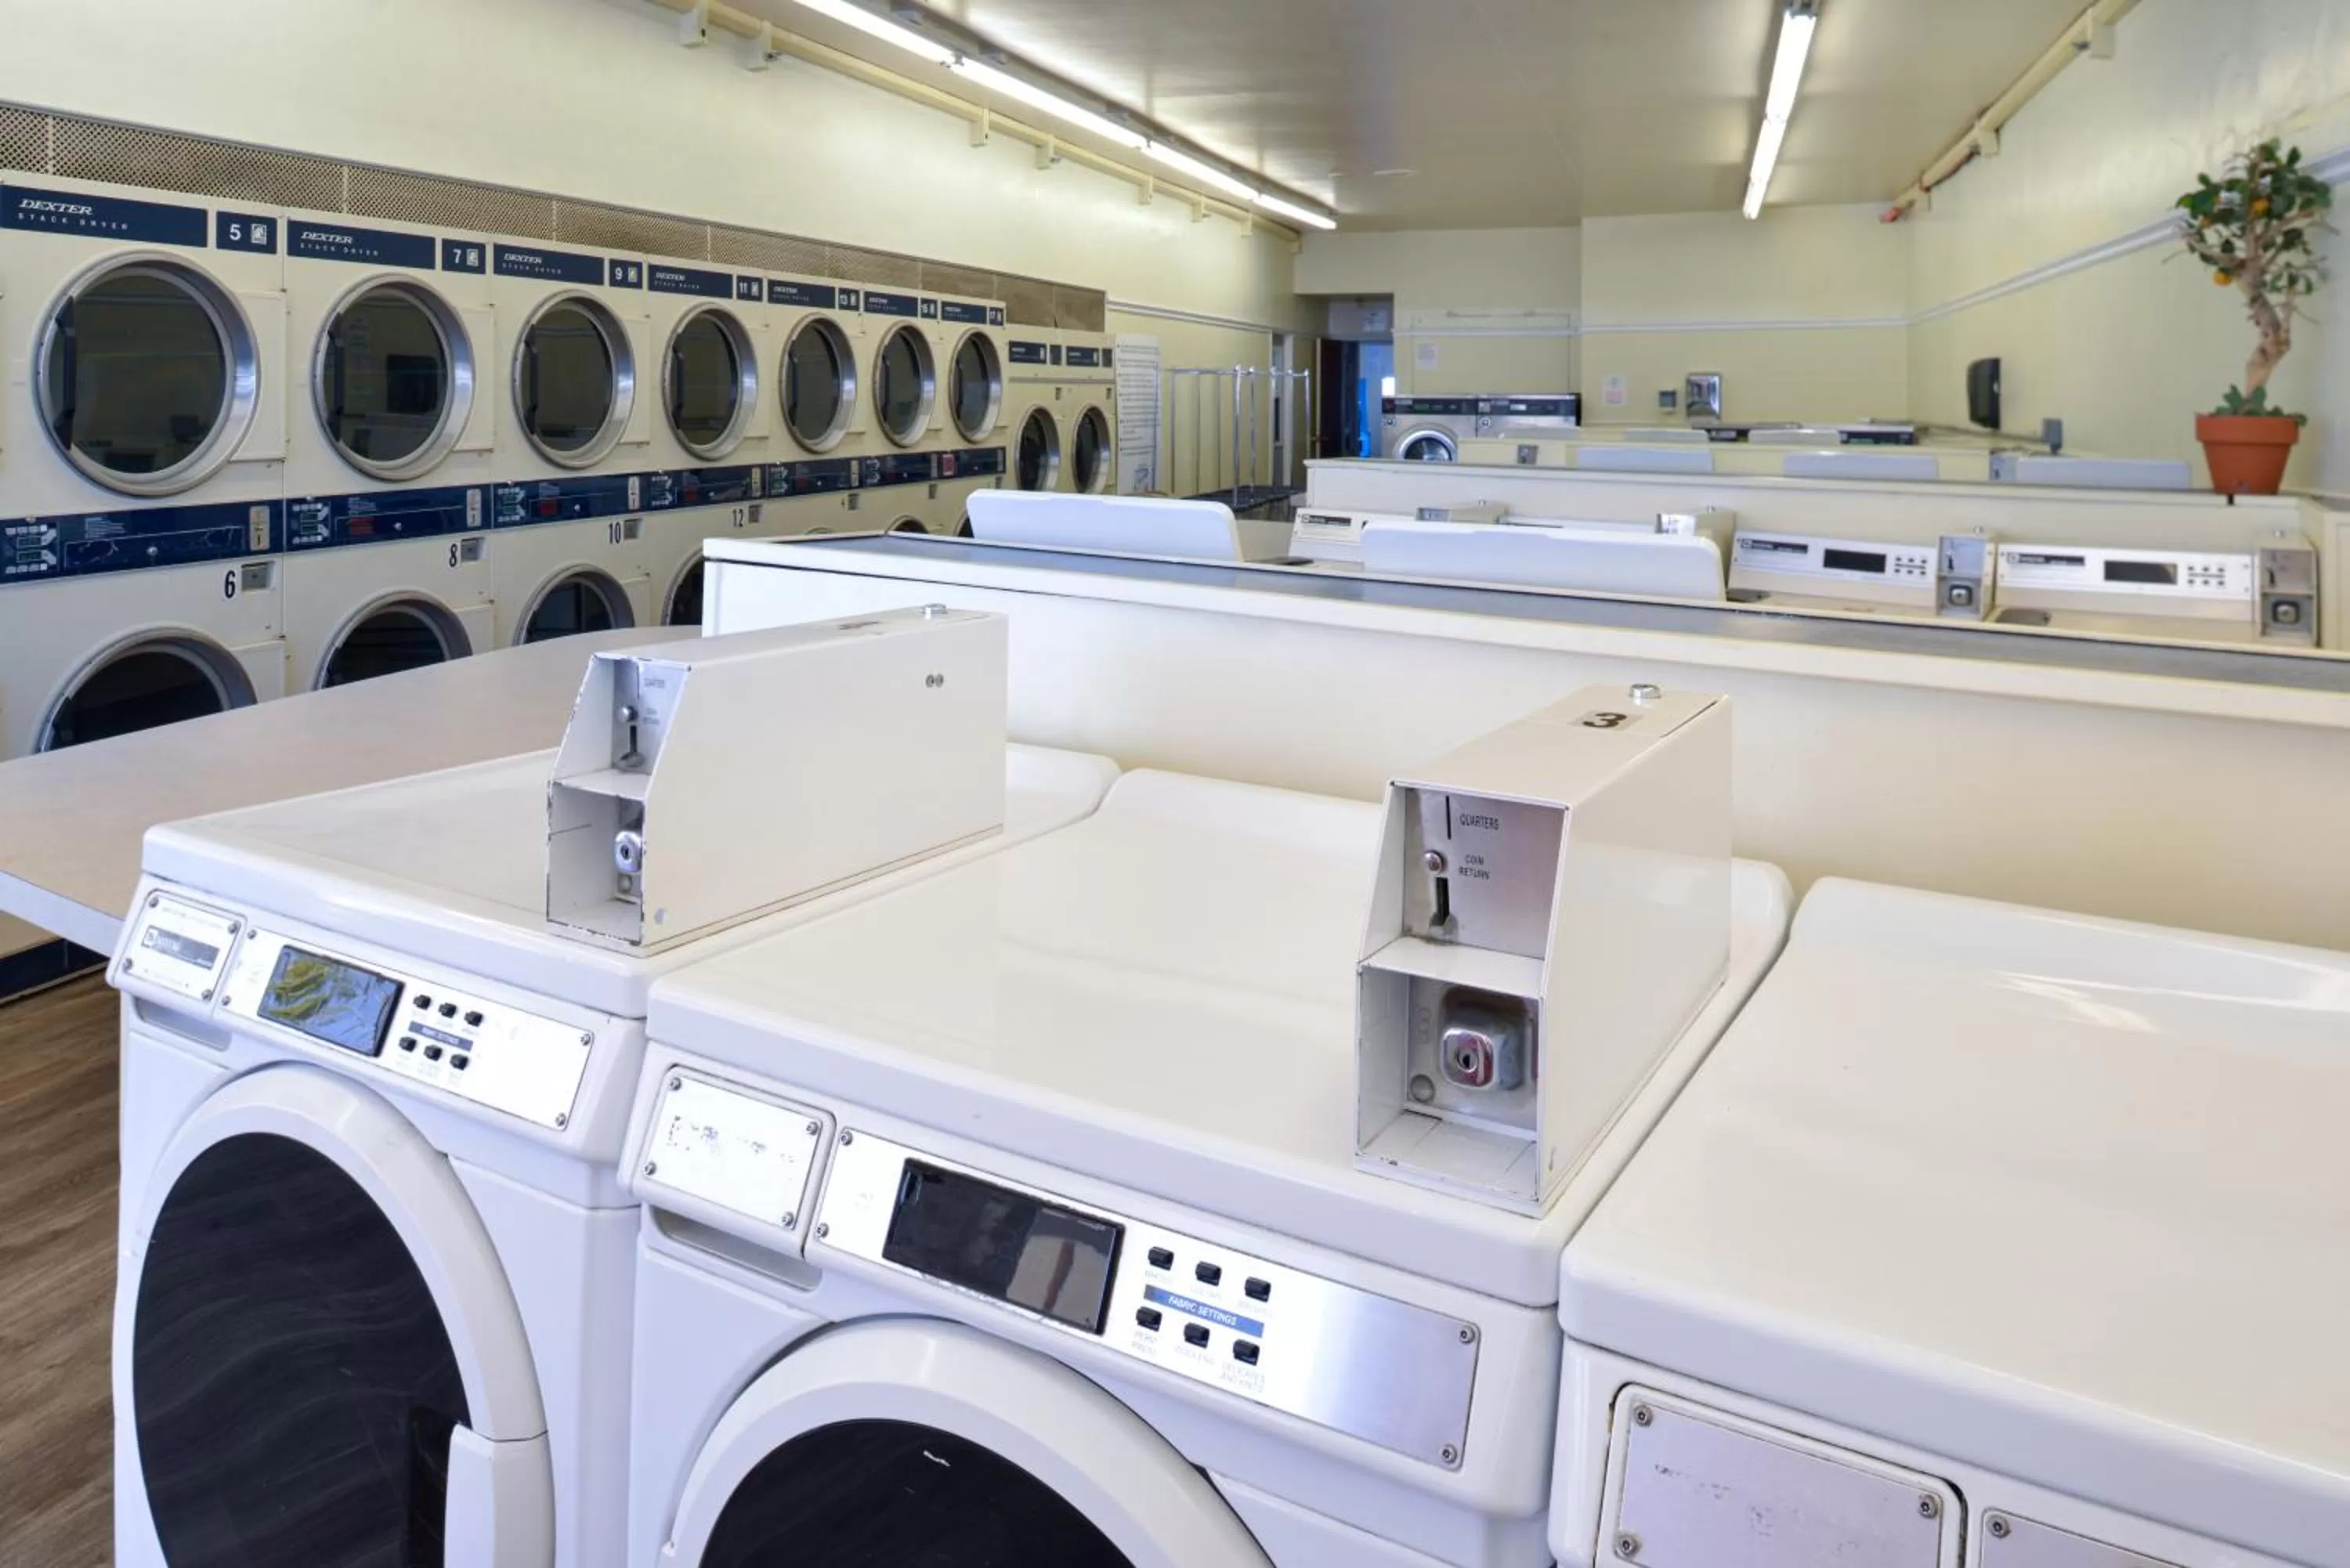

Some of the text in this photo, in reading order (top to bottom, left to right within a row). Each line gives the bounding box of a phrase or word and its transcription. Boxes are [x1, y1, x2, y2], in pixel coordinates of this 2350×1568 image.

[19, 198, 93, 215] DEXTER
[18, 212, 128, 231] STACK DRYER
[229, 223, 242, 240] 5
[300, 231, 353, 244] DEXTER
[453, 249, 462, 265] 7
[614, 266, 624, 280] 9
[739, 281, 748, 294] 11
[733, 508, 744, 528] 12
[608, 521, 622, 545] 10
[449, 543, 458, 568] 8
[224, 569, 237, 599] 6
[1582, 712, 1628, 729] 3
[1459, 814, 1499, 831] QUARTERS
[1464, 854, 1484, 865] COIN
[1459, 865, 1491, 881] RETURN
[1167, 1295, 1198, 1313] FABRIC
[1197, 1306, 1238, 1327] SETTINGS
